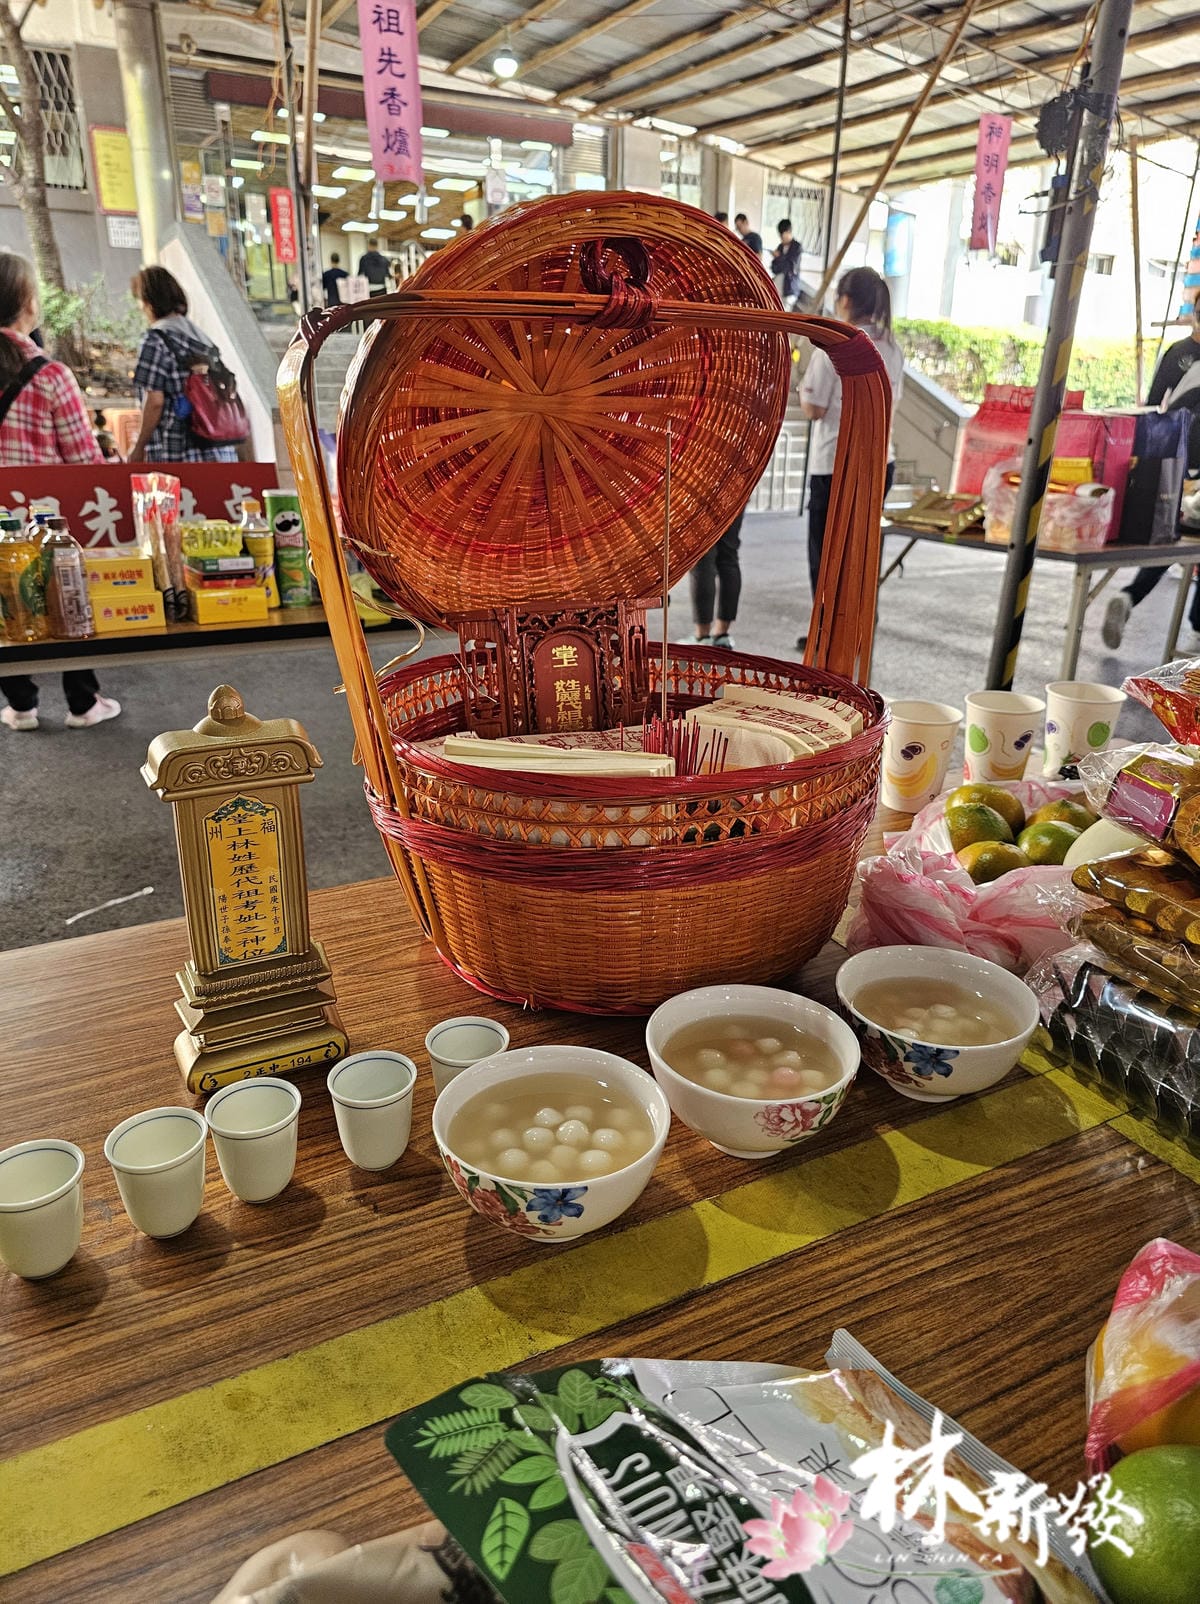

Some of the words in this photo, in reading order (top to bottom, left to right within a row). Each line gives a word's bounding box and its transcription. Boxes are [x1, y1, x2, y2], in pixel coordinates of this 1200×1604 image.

[371, 3, 412, 159] 祖先香爐
[665, 1463, 790, 1604] 味堅果
